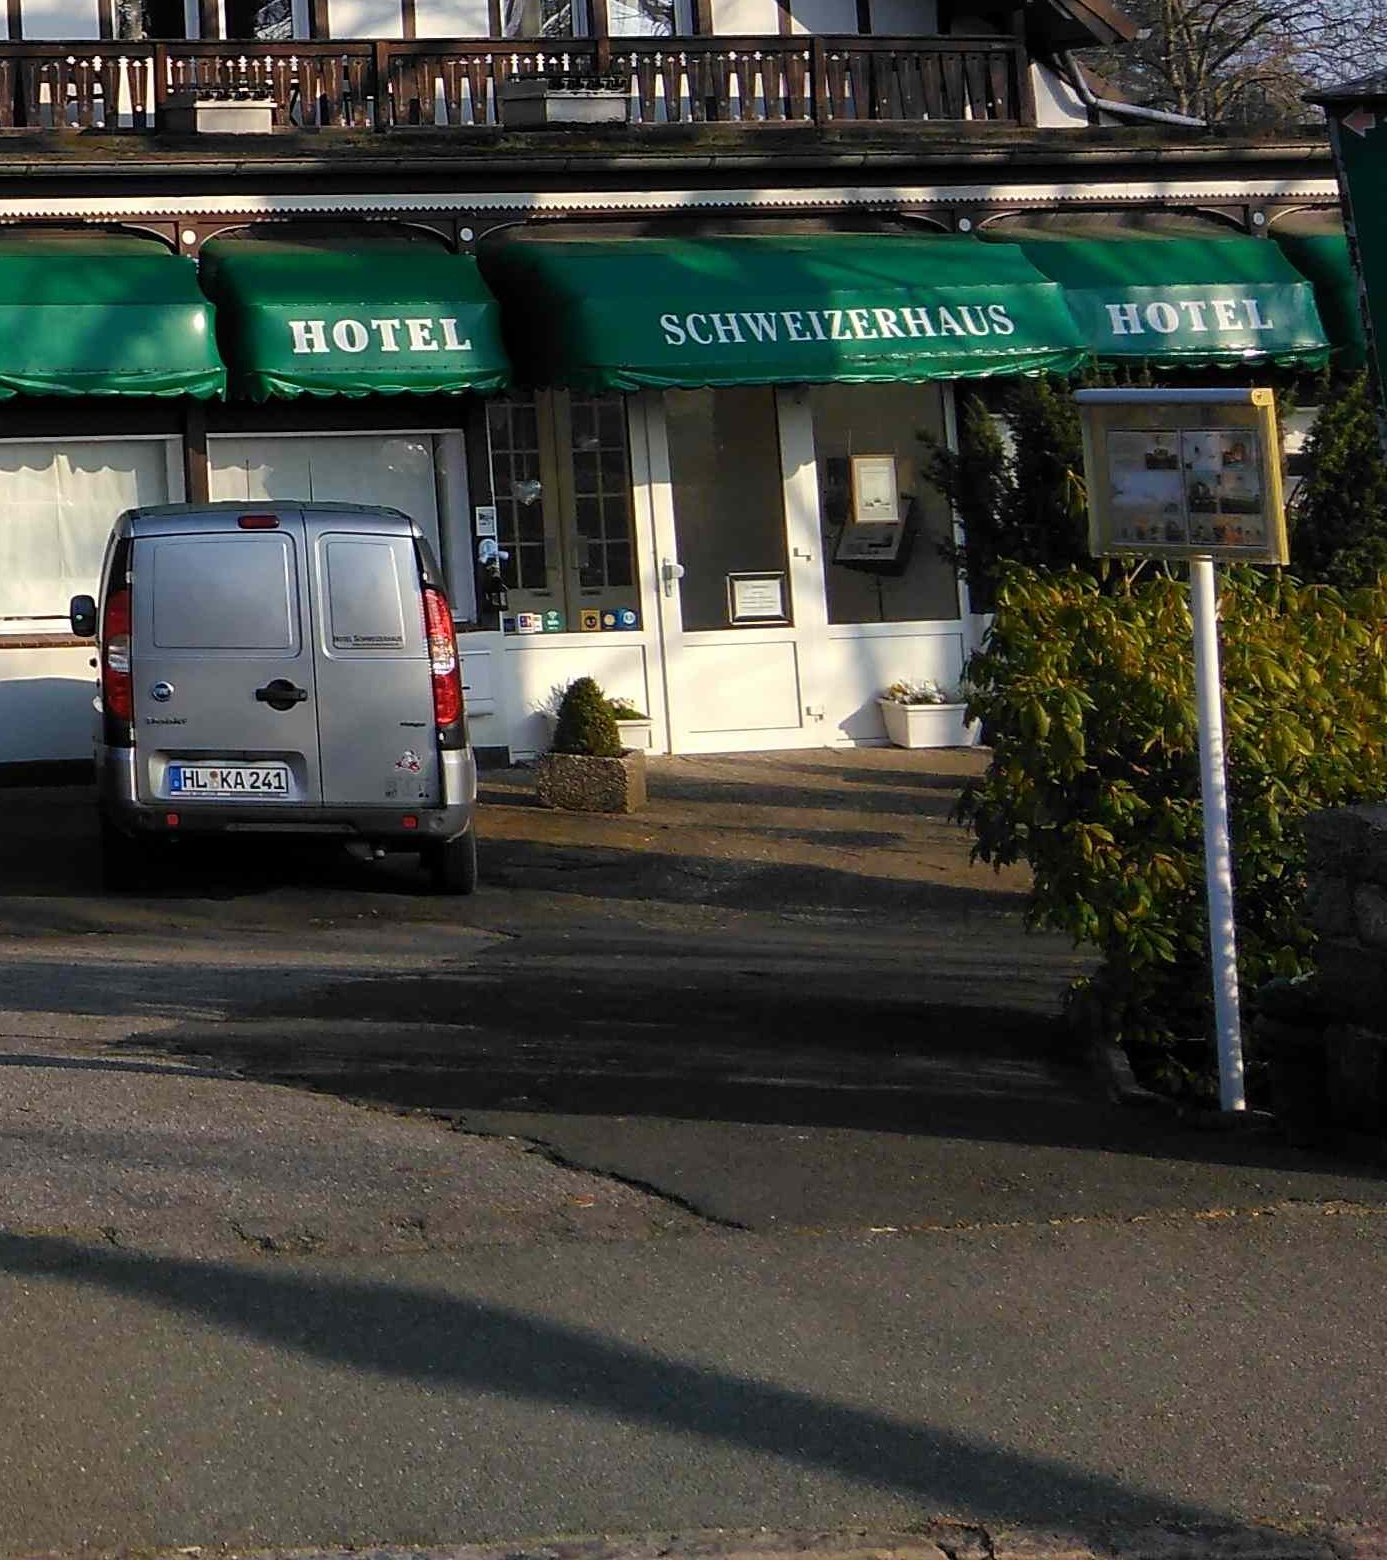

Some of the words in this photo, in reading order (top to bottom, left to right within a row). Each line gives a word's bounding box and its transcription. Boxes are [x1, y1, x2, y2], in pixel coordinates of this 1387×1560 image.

[660, 304, 1015, 345] SCHWEIZERHAUS
[1105, 299, 1274, 335] HOTEL
[288, 317, 472, 354] HOTEL
[182, 770, 208, 789] HL
[220, 771, 246, 789] KA
[249, 771, 285, 789] 241
